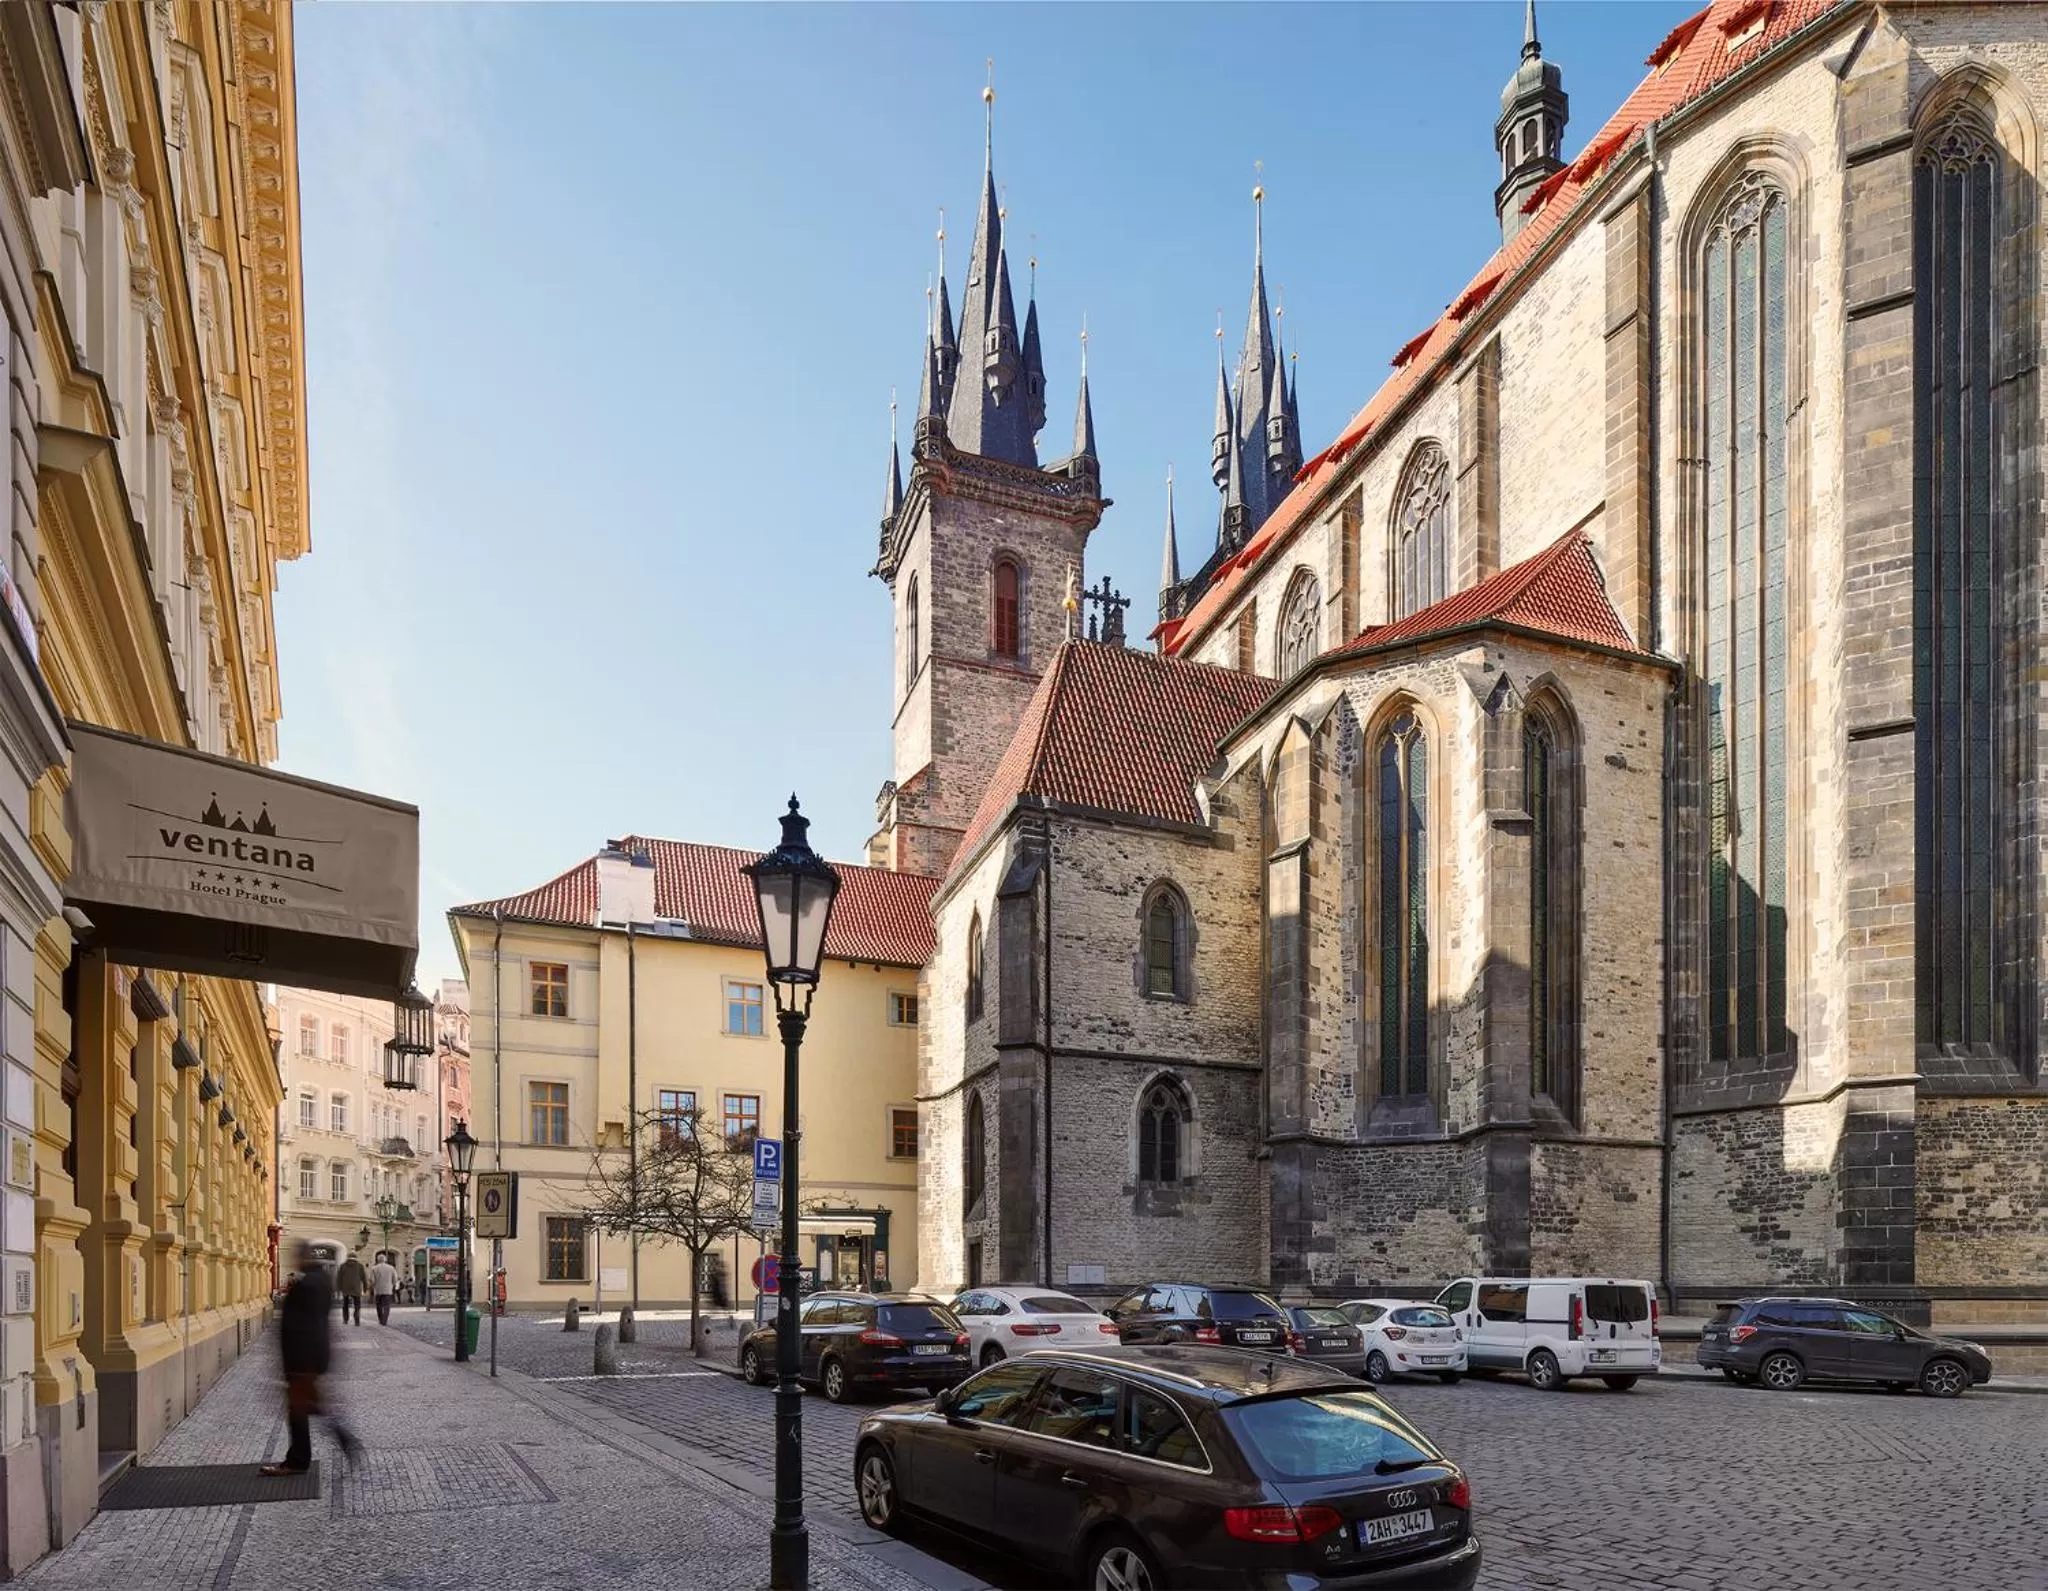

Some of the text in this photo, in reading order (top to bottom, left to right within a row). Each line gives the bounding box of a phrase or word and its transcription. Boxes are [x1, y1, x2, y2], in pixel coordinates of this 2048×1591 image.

[159, 828, 315, 872] ventana
[190, 881, 287, 905] Hotel Prague
[760, 1143, 777, 1167] P
[1368, 1516, 1393, 1541] 2AH
[1399, 1511, 1427, 1534] 3447
